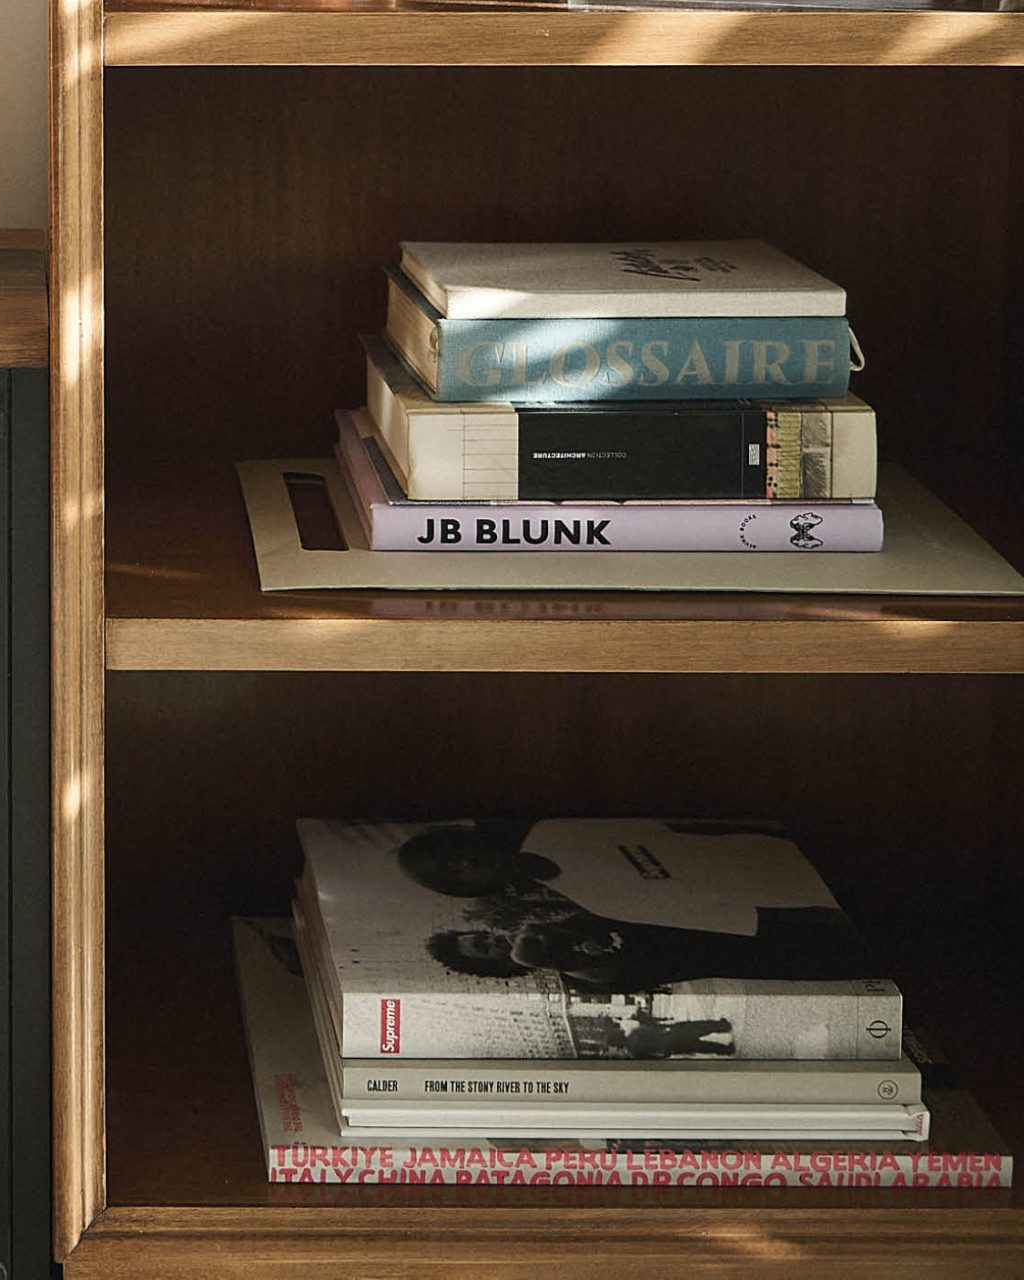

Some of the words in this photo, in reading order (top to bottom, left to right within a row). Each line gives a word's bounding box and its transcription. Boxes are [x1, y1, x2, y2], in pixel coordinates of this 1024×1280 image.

[458, 337, 841, 388] GLOSSAIRE
[532, 451, 587, 459] ARCHITECTURE
[417, 519, 462, 546] JB
[476, 519, 612, 546] BLUNK
[382, 999, 398, 1053] Supreme
[367, 1080, 398, 1092] CALDER
[425, 1080, 448, 1093] FROM
[450, 1081, 466, 1093] THE
[467, 1081, 494, 1093] STONY
[496, 1081, 521, 1094] RIVER
[523, 1081, 534, 1094] TO
[536, 1081, 551, 1094] THE
[553, 1082, 569, 1094] SKY
[403, 1144, 538, 1169] JAMAICA
[626, 1148, 762, 1171] LEBANON
[774, 1150, 900, 1172] ALGERIA
[909, 1151, 1002, 1172] YEMEN
